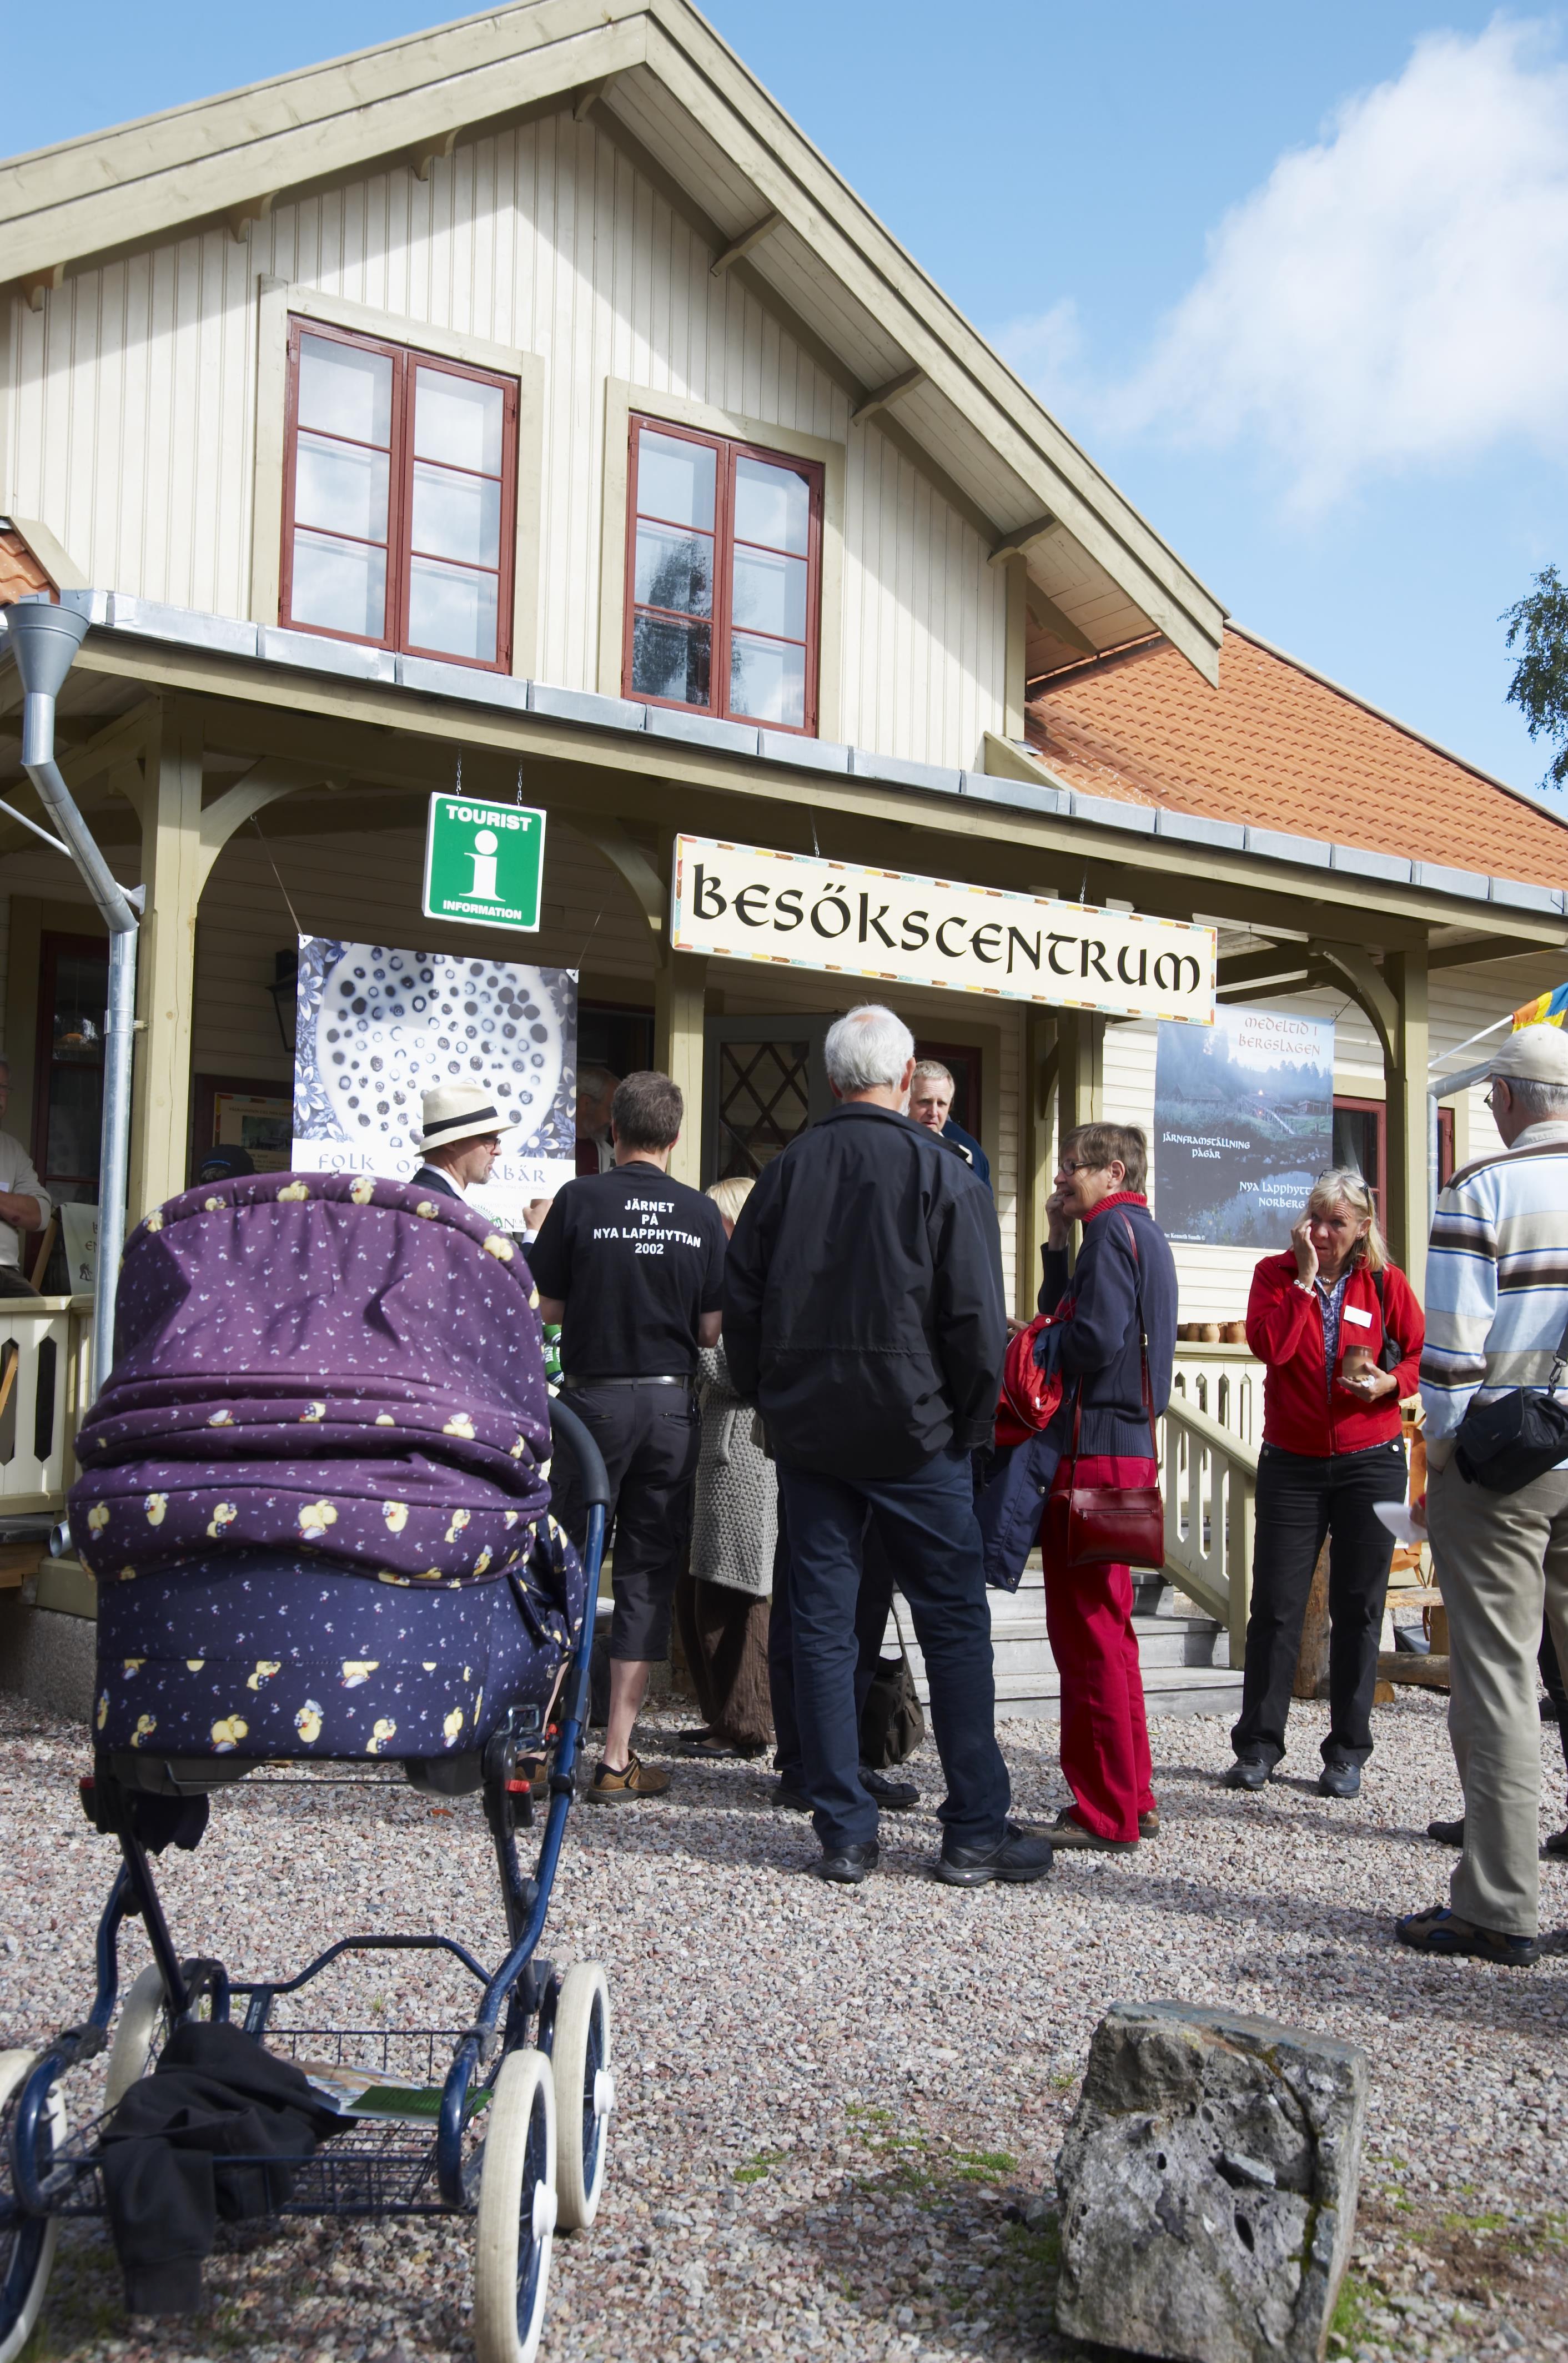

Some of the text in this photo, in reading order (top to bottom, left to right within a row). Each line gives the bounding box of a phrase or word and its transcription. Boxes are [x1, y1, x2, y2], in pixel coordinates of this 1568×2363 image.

[446, 805, 532, 832] TOURIST
[443, 900, 522, 921] INFORMATION
[692, 863, 1201, 994] BESÖKSCENTRUM
[1244, 1017, 1309, 1035] MEDELTID
[1239, 1033, 1320, 1056] BERGSLAGEN
[1163, 1132, 1250, 1149] JÄRNFRAMSTÄLLNING
[1192, 1148, 1221, 1159] PÅGÅR
[319, 1153, 375, 1170] FOLK
[396, 1160, 425, 1173] OC
[625, 1198, 675, 1213] JÄRNET
[1258, 1197, 1305, 1209] NORBERG
[642, 1213, 659, 1225] PÅ
[594, 1228, 701, 1248] NYA LAPPHYTTAN
[635, 1243, 664, 1255] 2002
